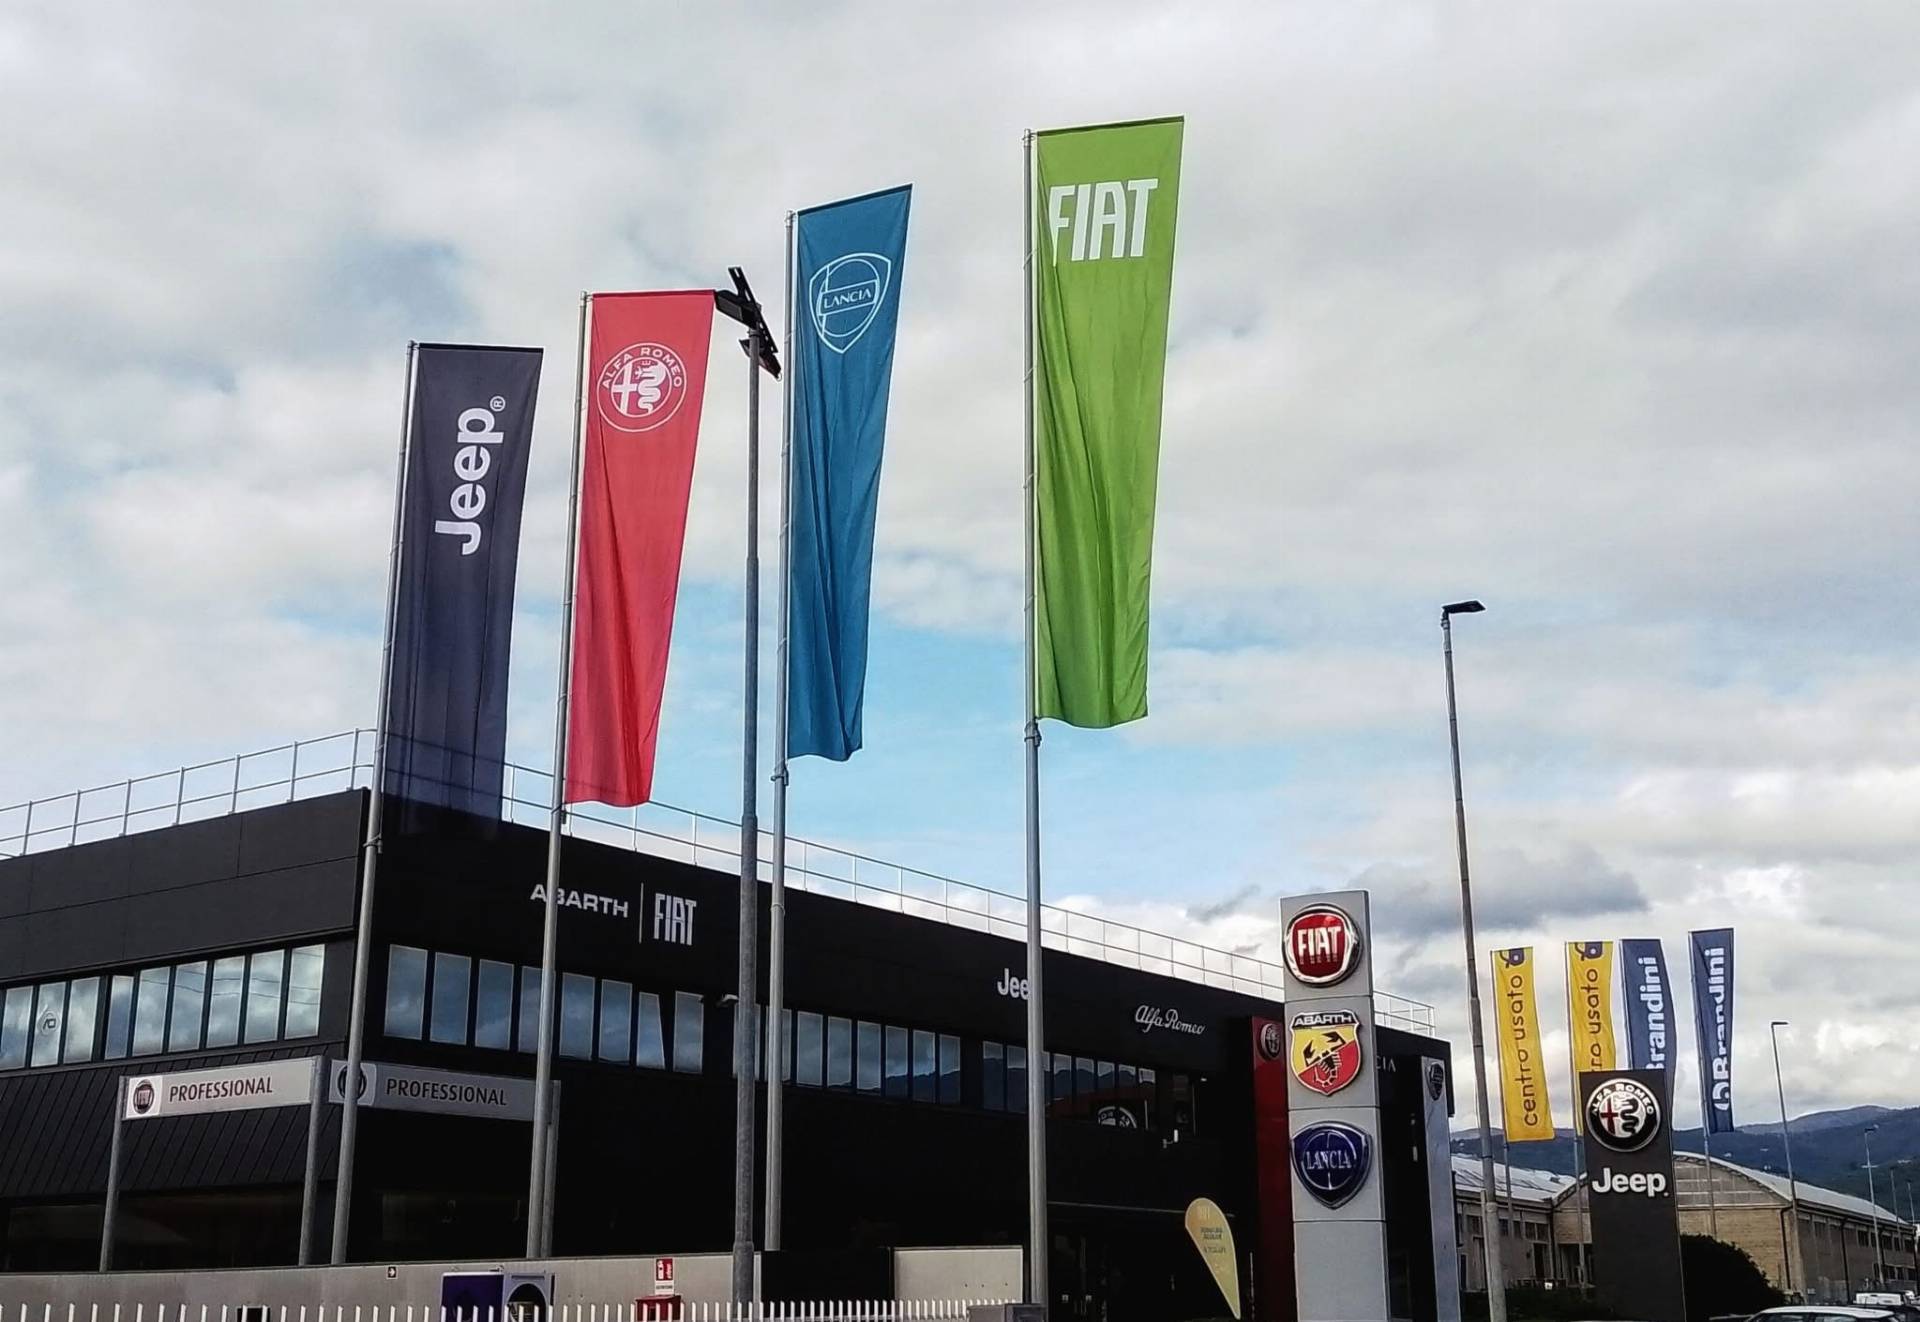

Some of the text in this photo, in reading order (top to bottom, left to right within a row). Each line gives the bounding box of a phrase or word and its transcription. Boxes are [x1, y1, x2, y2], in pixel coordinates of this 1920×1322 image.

[1048, 178, 1159, 266] FIAT
[824, 288, 871, 309] LANCIA
[602, 347, 682, 389] ALFA ROMEO
[653, 892, 697, 946] FIAT
[1297, 925, 1342, 963] FIAT
[997, 967, 1029, 1001] Jee
[1581, 968, 1602, 1035] usato
[1134, 1004, 1206, 1035] Alfa Romeo
[1294, 1014, 1352, 1026] ABARTH
[1507, 974, 1538, 1126] centro usato
[169, 1076, 273, 1102] PROFESSIONAL
[386, 1078, 508, 1106] PROFESSIONAL
[1592, 1083, 1655, 1115] ALFA ROMEO
[1306, 1151, 1353, 1171] LANCIA
